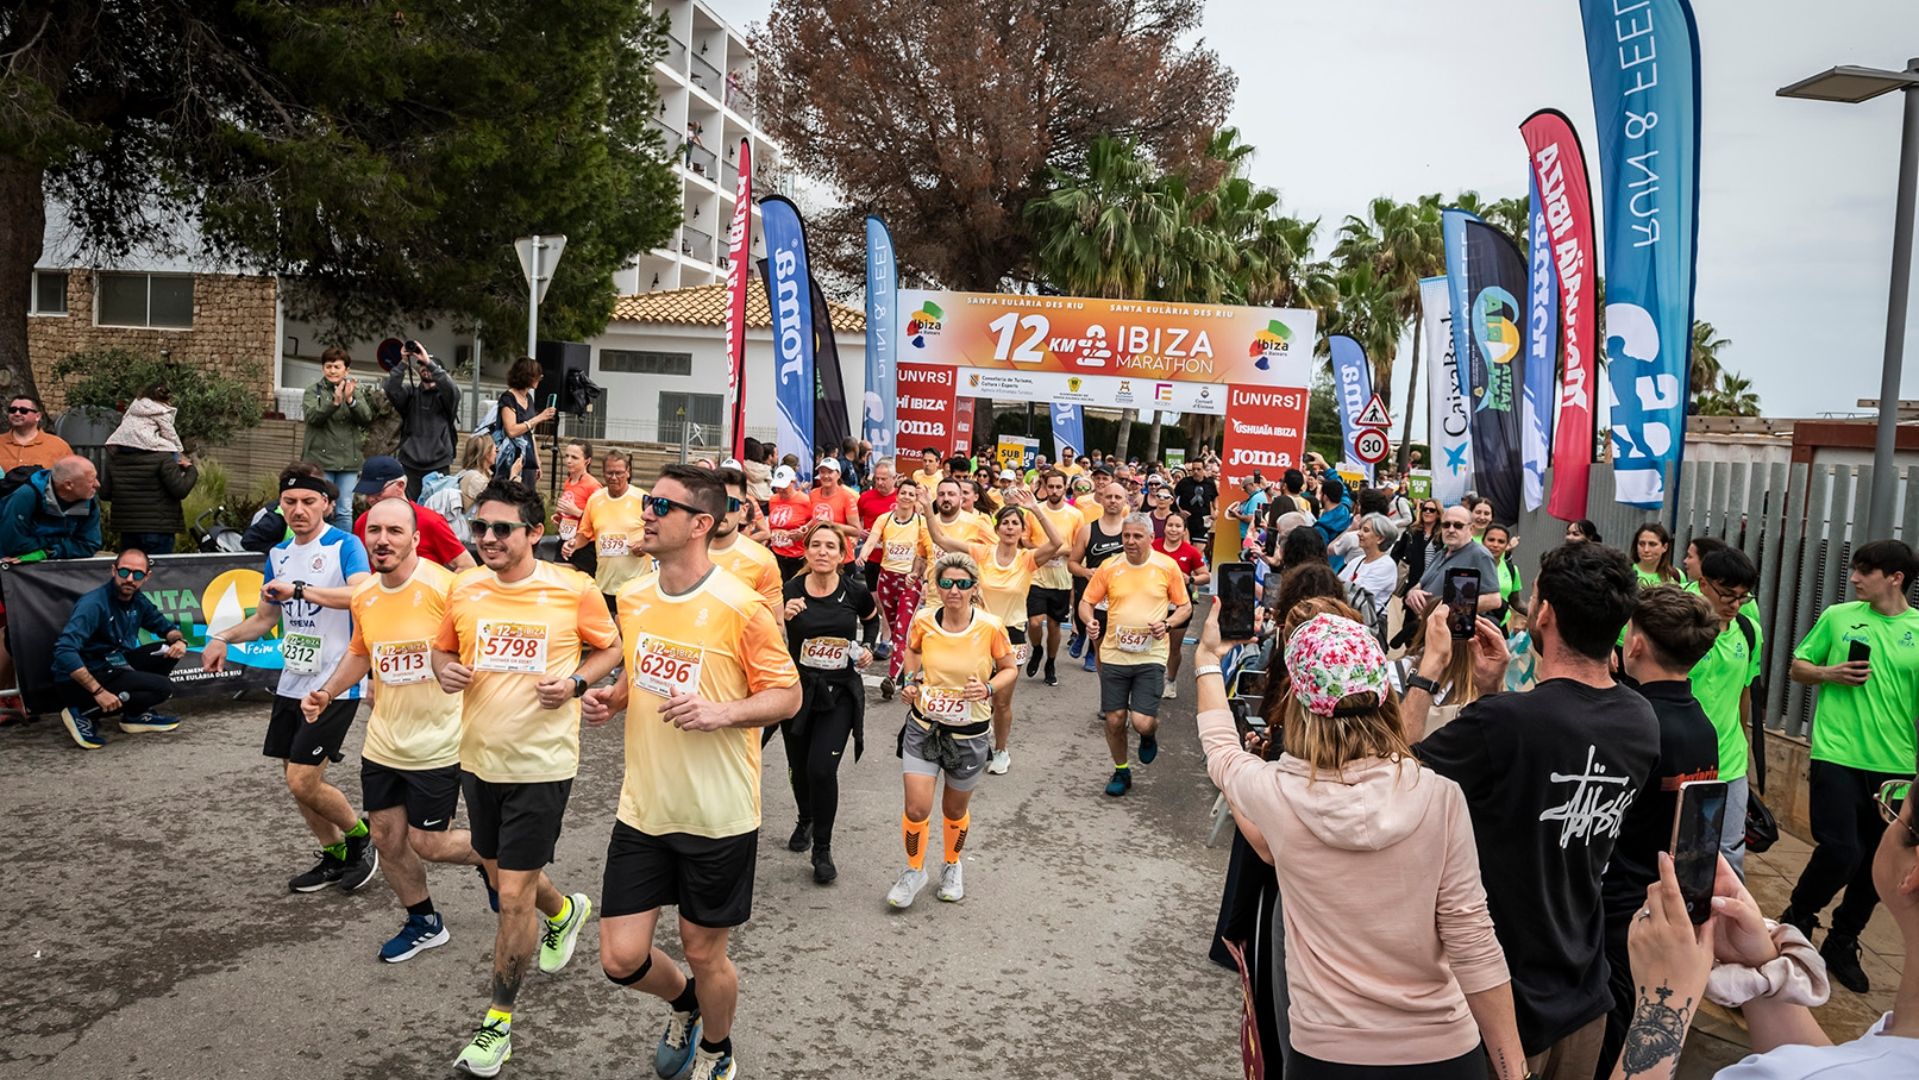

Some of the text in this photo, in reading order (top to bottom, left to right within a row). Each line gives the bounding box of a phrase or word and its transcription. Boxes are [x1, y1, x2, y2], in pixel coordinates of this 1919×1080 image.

[967, 297, 998, 306] SANTA
[1045, 300, 1063, 309] DES
[1067, 302, 1084, 310] RIU
[1110, 304, 1142, 313] SANTA
[1193, 308, 1212, 317] DES
[1215, 310, 1234, 318] RIU
[989, 312, 1078, 363] 12 KM
[1117, 325, 1214, 359] IBIZA
[1115, 354, 1214, 374] MARATHON
[896, 368, 952, 386] UNVRS]
[910, 397, 946, 411] IBIZA
[1232, 390, 1302, 411] [UNVRS]
[1273, 426, 1297, 438] IBIZA
[1361, 439, 1382, 453] 30
[1001, 449, 1020, 458] SUB
[1023, 451, 1034, 460] UB
[601, 540, 624, 550] 6379
[889, 547, 911, 555] 6227
[143, 589, 201, 610] NTA
[1120, 633, 1148, 645] 6547
[284, 644, 315, 663] 2312
[484, 637, 538, 658] 5798
[808, 645, 844, 660] 6446
[380, 653, 425, 673] 6113
[641, 653, 692, 683] 6296
[185, 672, 215, 681] EULÀRIA
[215, 670, 229, 679] DES
[229, 669, 242, 677] RIU
[927, 699, 965, 713] 6375
